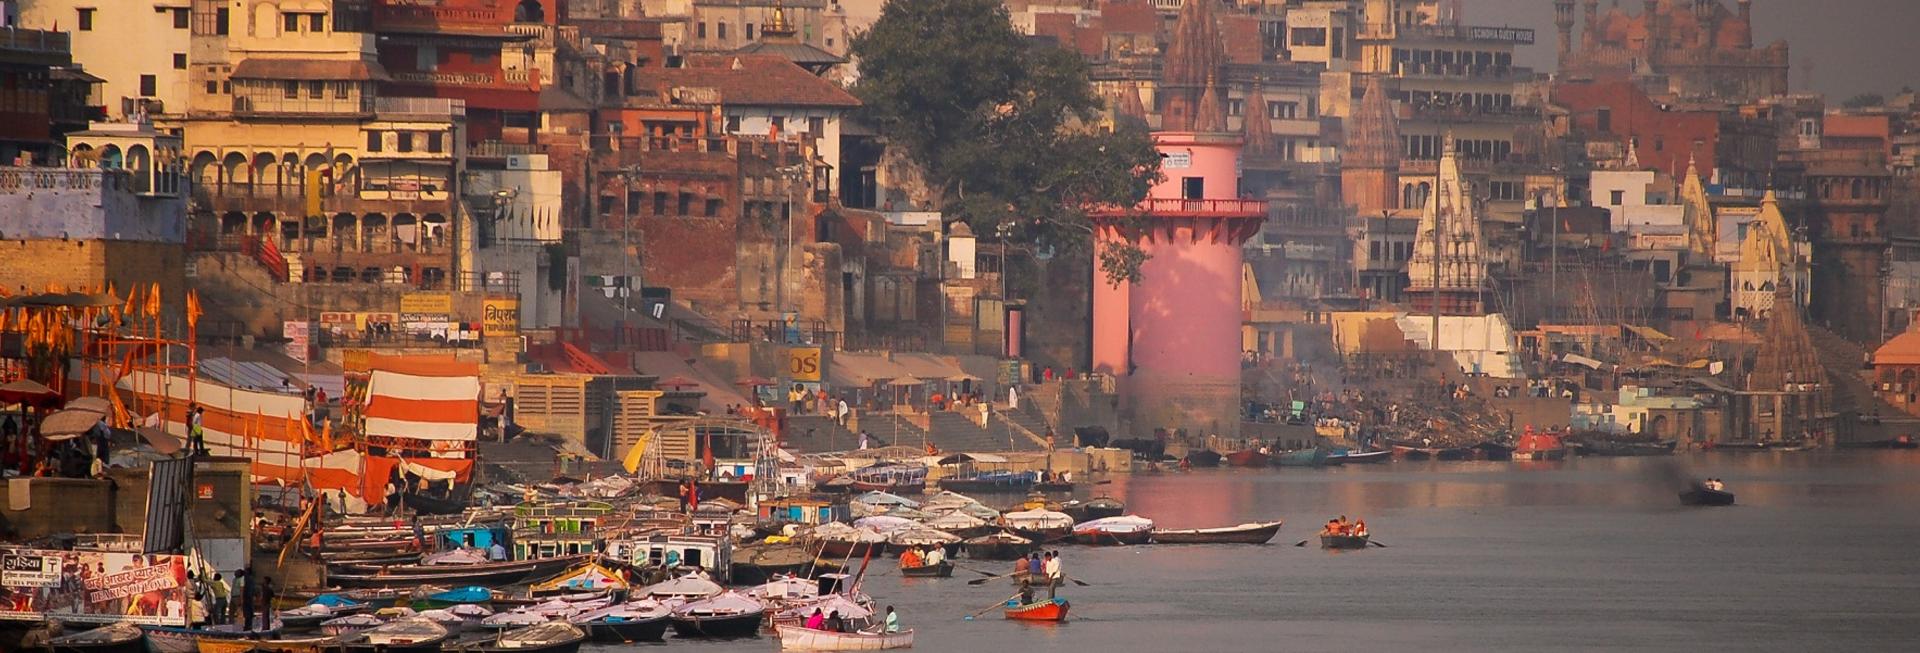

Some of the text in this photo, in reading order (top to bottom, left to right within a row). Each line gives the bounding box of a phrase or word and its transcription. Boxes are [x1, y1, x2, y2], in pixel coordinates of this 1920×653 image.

[1499, 29, 1515, 40] GUEST
[1516, 30, 1533, 41] HOUSE
[6, 556, 40, 570] गुड़िया
